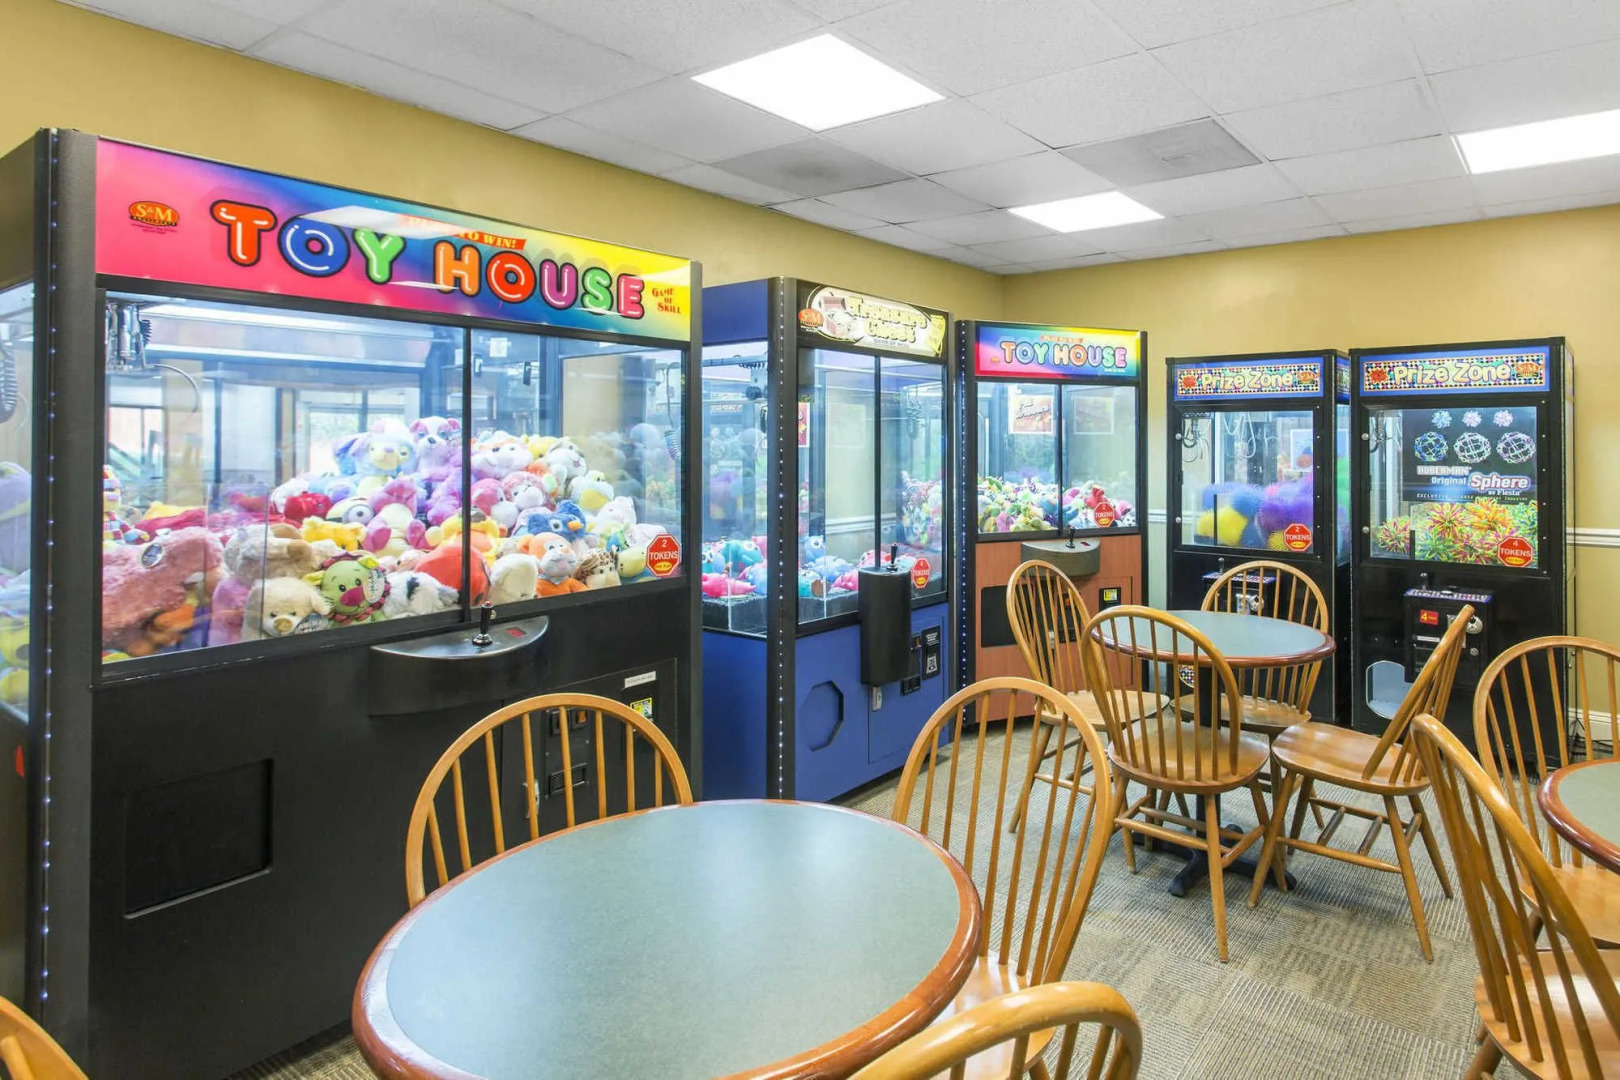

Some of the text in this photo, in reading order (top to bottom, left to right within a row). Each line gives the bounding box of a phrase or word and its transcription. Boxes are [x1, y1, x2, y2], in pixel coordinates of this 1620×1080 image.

[483, 234, 516, 249] WIN!
[209, 199, 645, 319] TOY HOUSE
[1000, 341, 1127, 369] TOY HOUSE
[1202, 372, 1246, 391] Prize
[1249, 370, 1294, 390] Zone
[1394, 364, 1449, 387] Prize
[1452, 362, 1511, 384] Zone
[1431, 473, 1529, 491] Original Sphere
[661, 539, 668, 548] 2
[650, 551, 678, 560] TOKENS
[1500, 548, 1531, 557] TOKENS
[1421, 612, 1428, 622] 4
